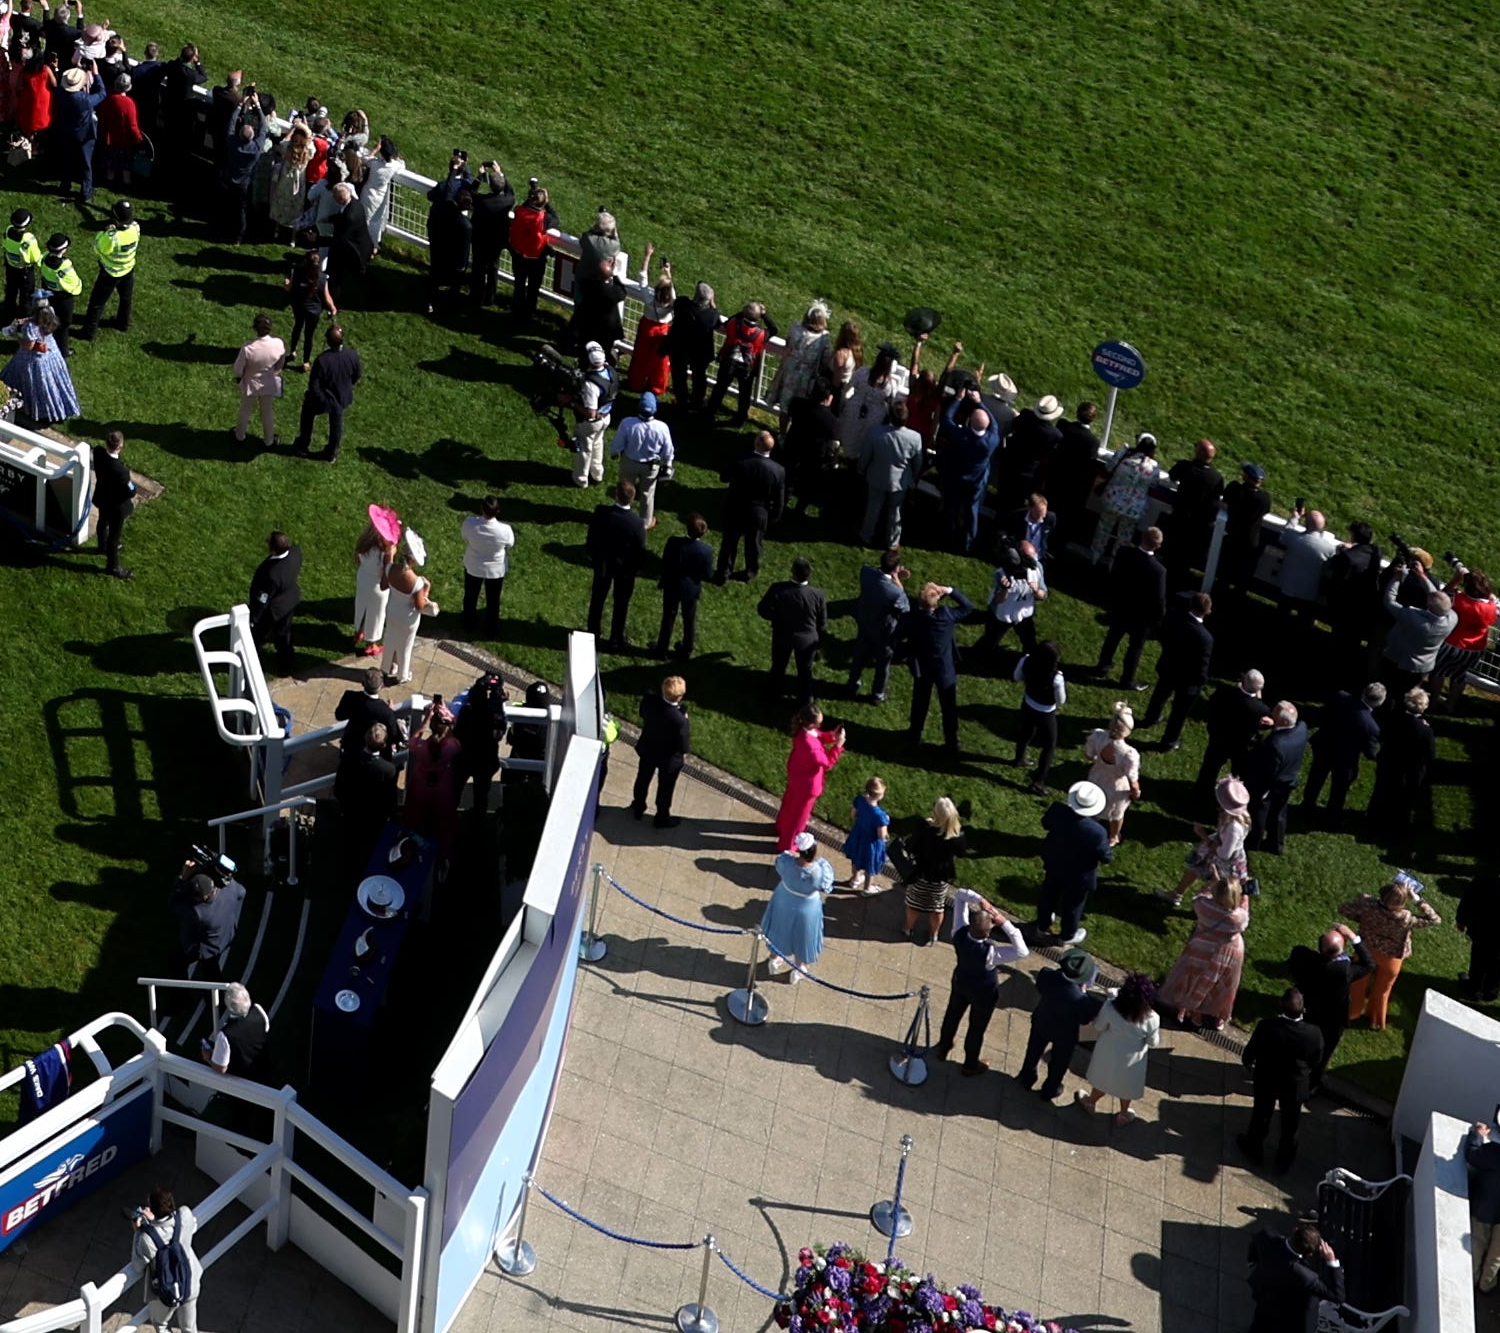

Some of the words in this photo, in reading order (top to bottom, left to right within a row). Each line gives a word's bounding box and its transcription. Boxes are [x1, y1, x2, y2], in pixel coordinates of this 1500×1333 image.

[1095, 355, 1140, 377] BETFRED
[1101, 348, 1136, 367] SECOND
[6, 1144, 117, 1231] BETFRED
